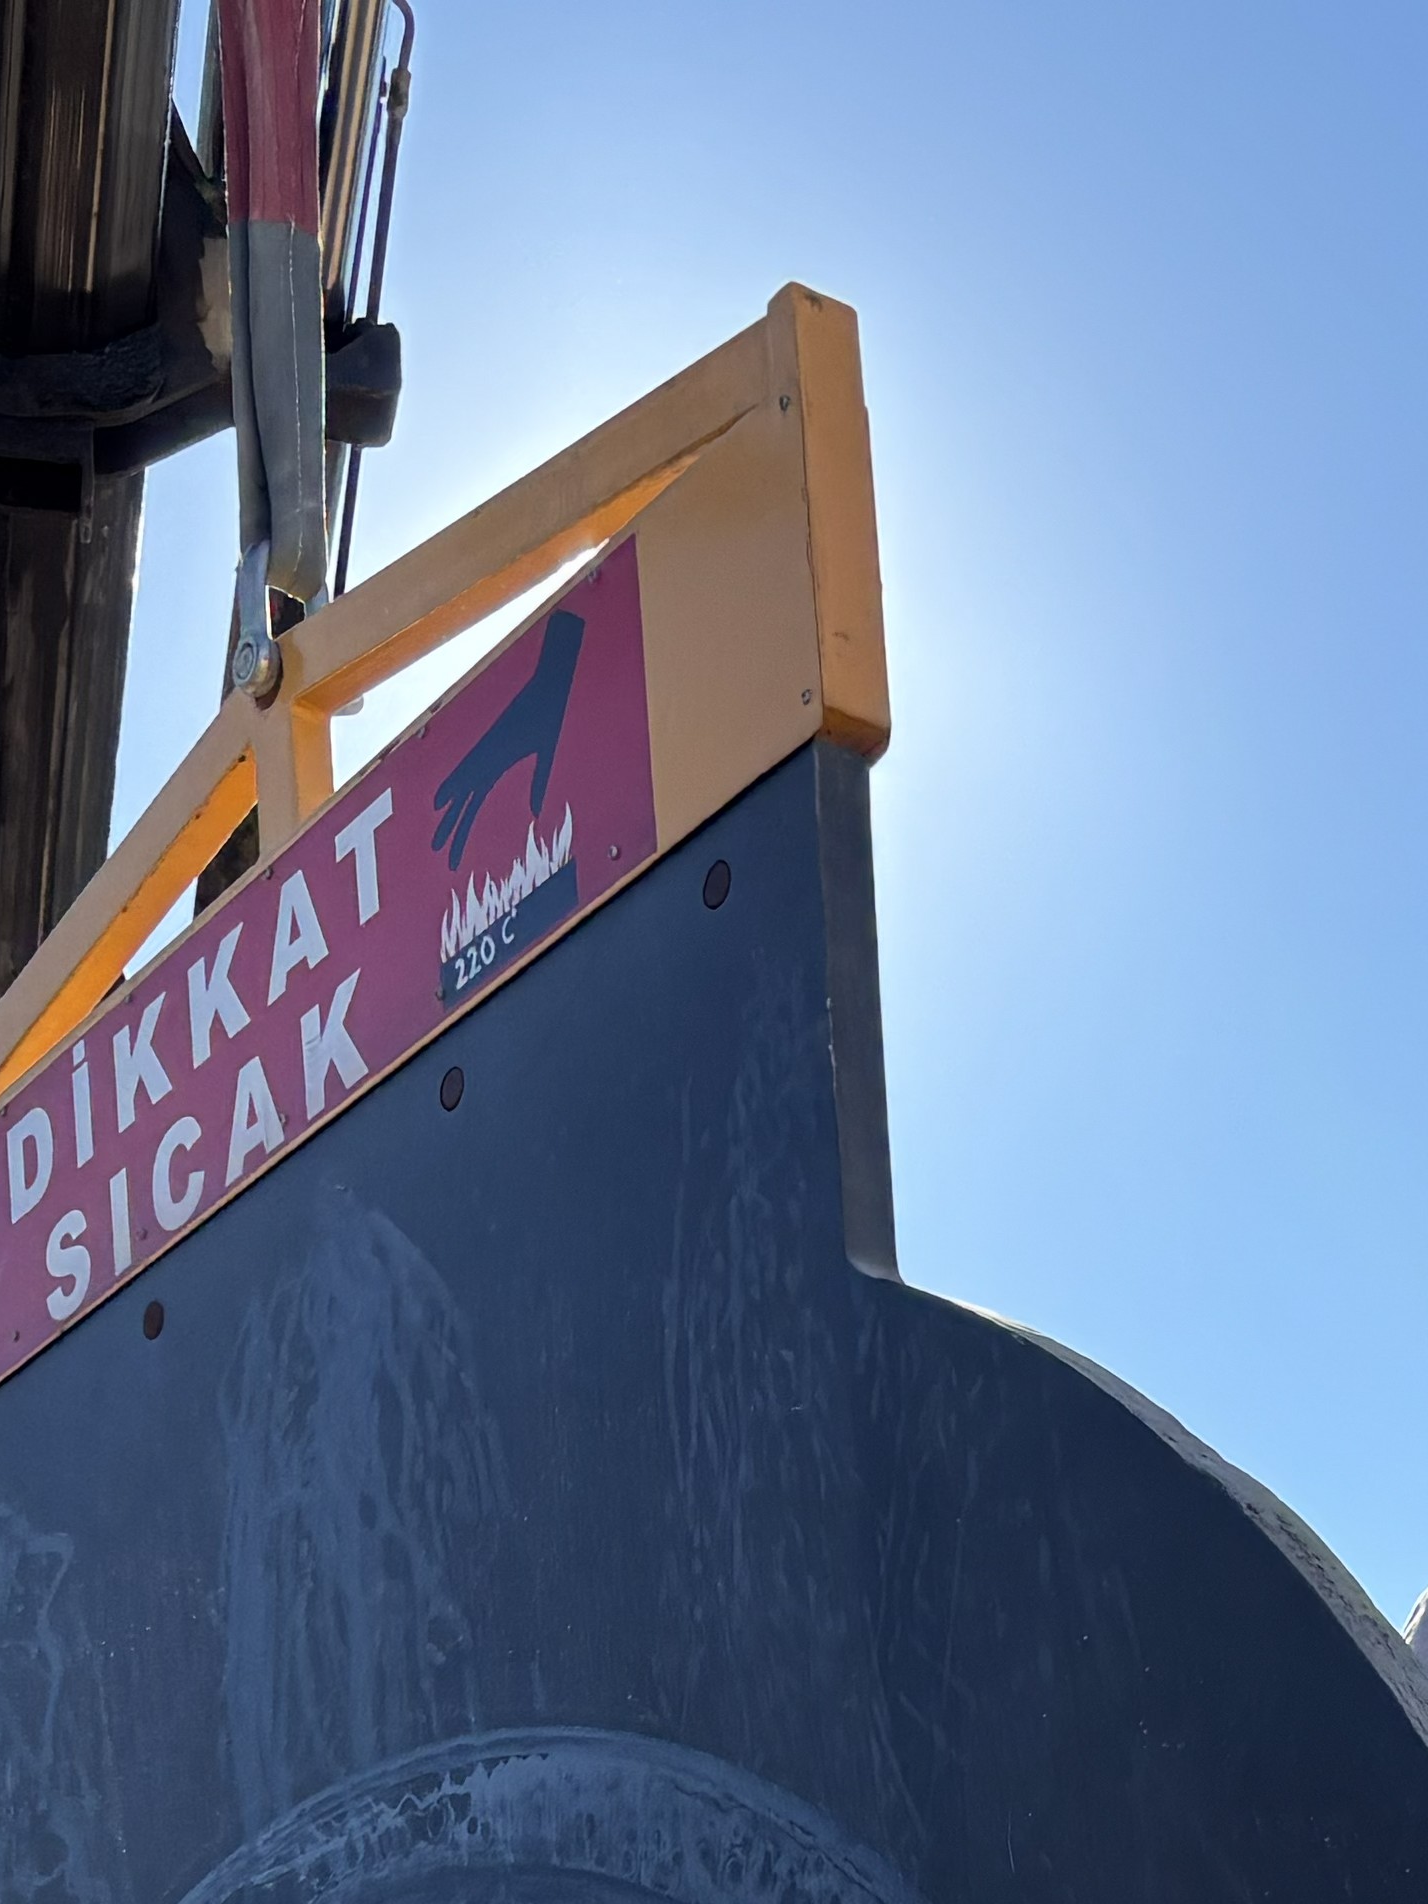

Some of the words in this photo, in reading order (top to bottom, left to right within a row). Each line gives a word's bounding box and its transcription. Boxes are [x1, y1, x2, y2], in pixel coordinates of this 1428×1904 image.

[6, 787, 394, 1225] DİKKAT
[454, 934, 496, 991] 220
[45, 967, 369, 1321] SICAK
